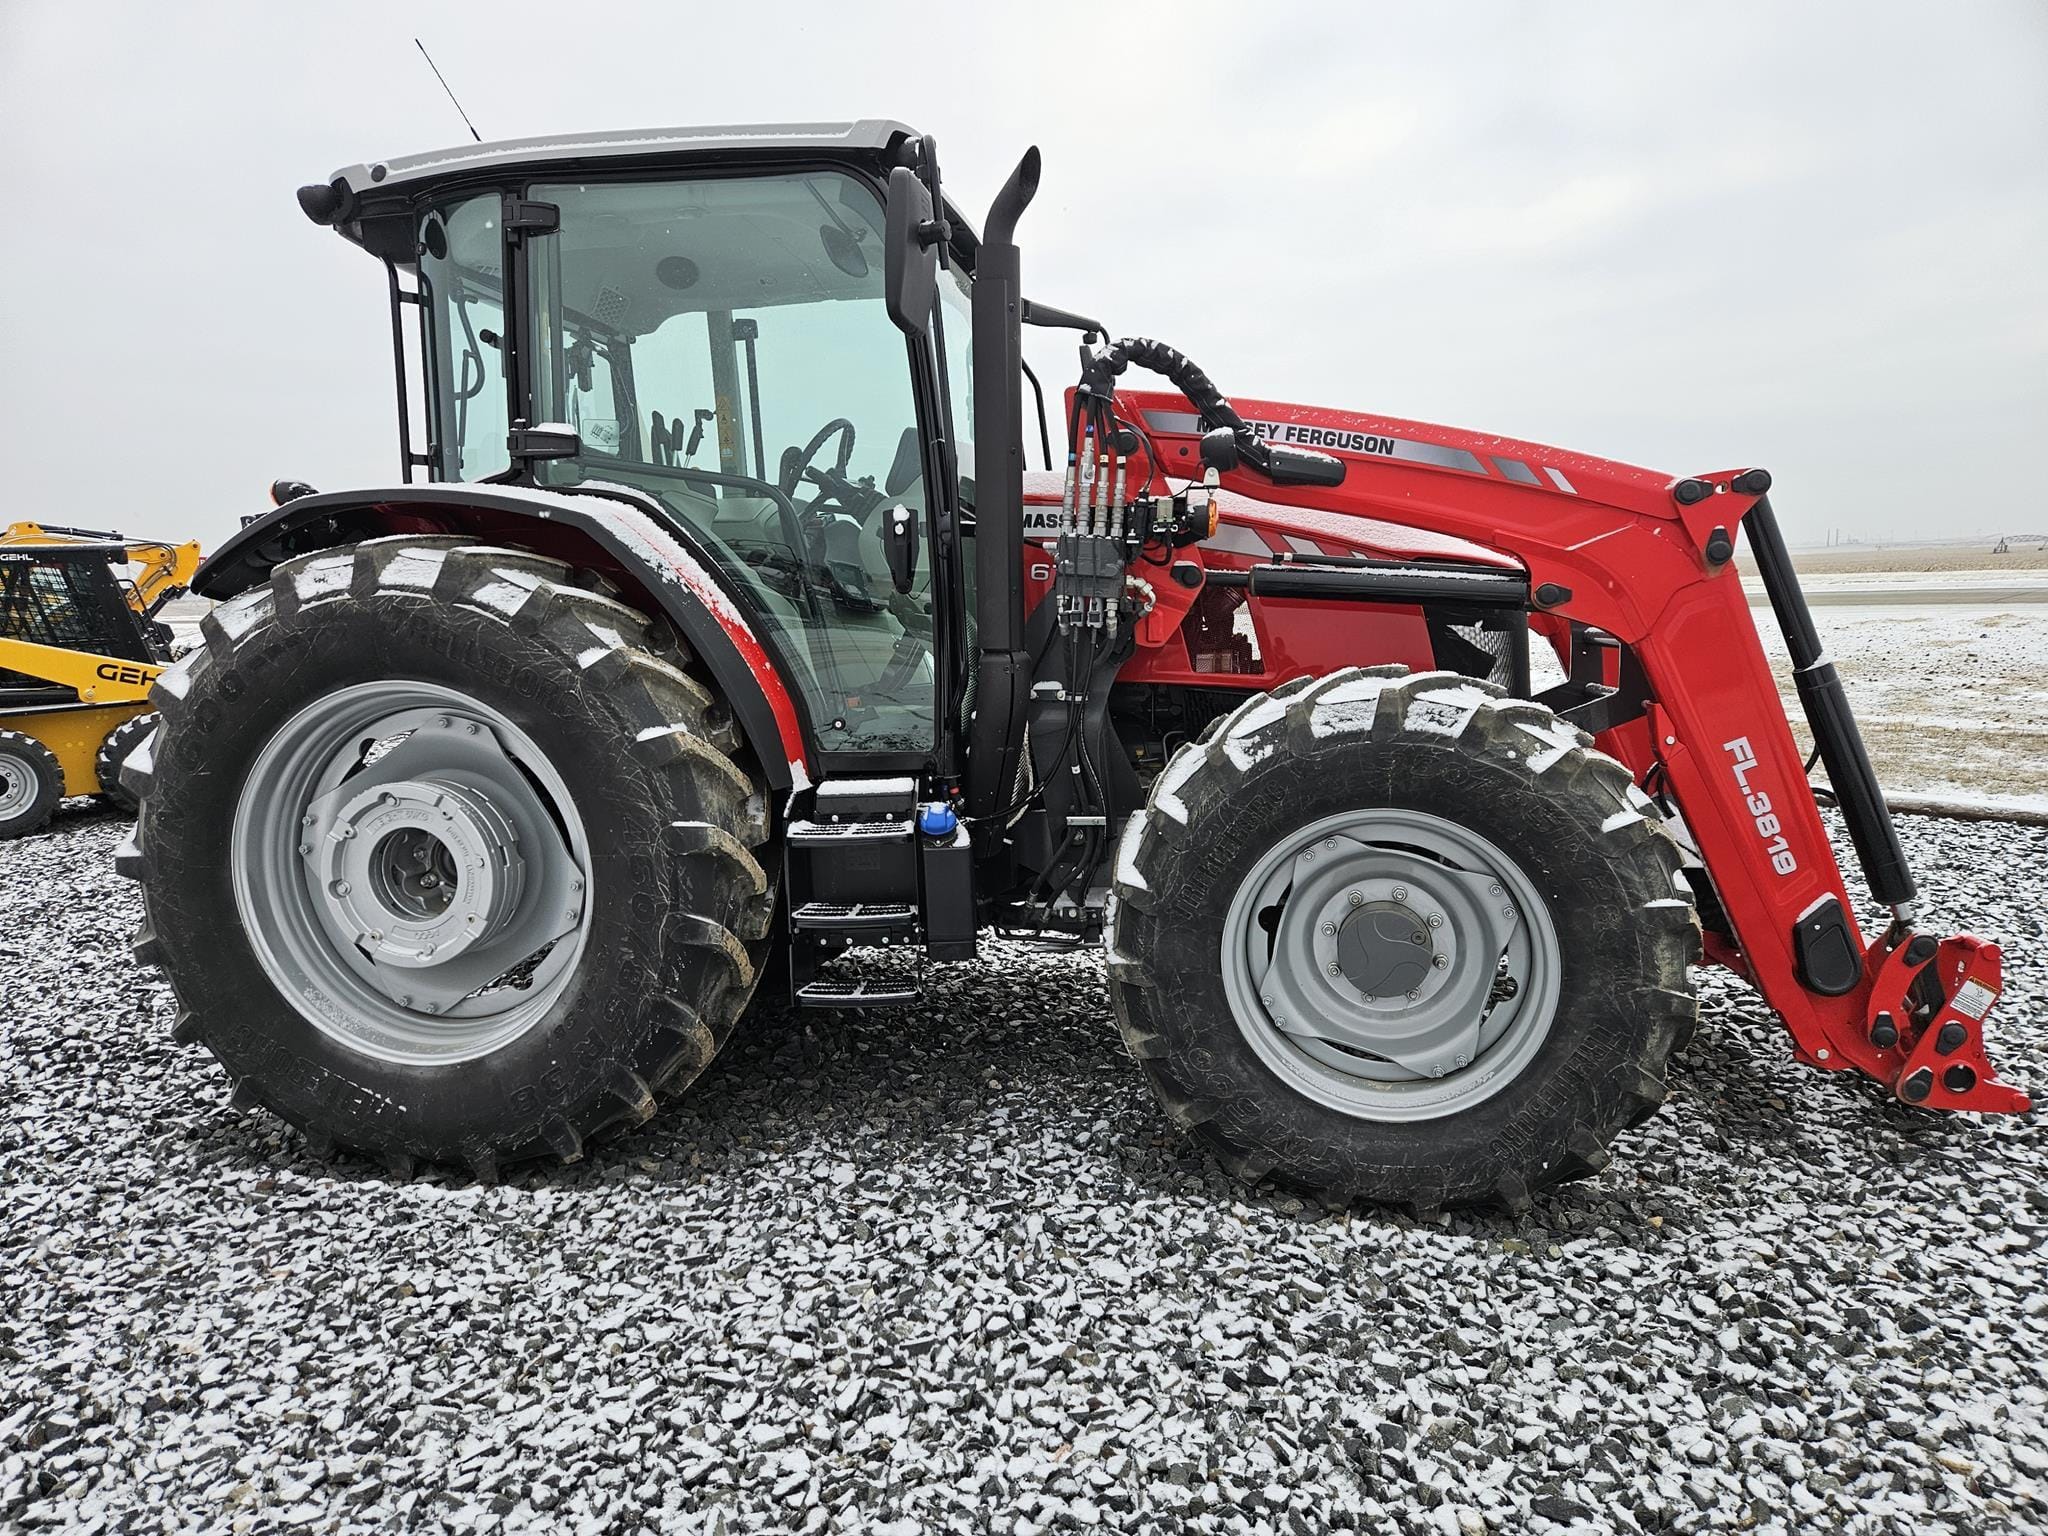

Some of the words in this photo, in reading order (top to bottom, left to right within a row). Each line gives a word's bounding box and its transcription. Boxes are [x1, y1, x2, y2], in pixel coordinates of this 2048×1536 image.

[1285, 426, 1395, 456] FERGUSON
[0, 553, 34, 561] GEHL
[96, 663, 162, 686] GEH
[1722, 736, 1798, 876] FL.3819
